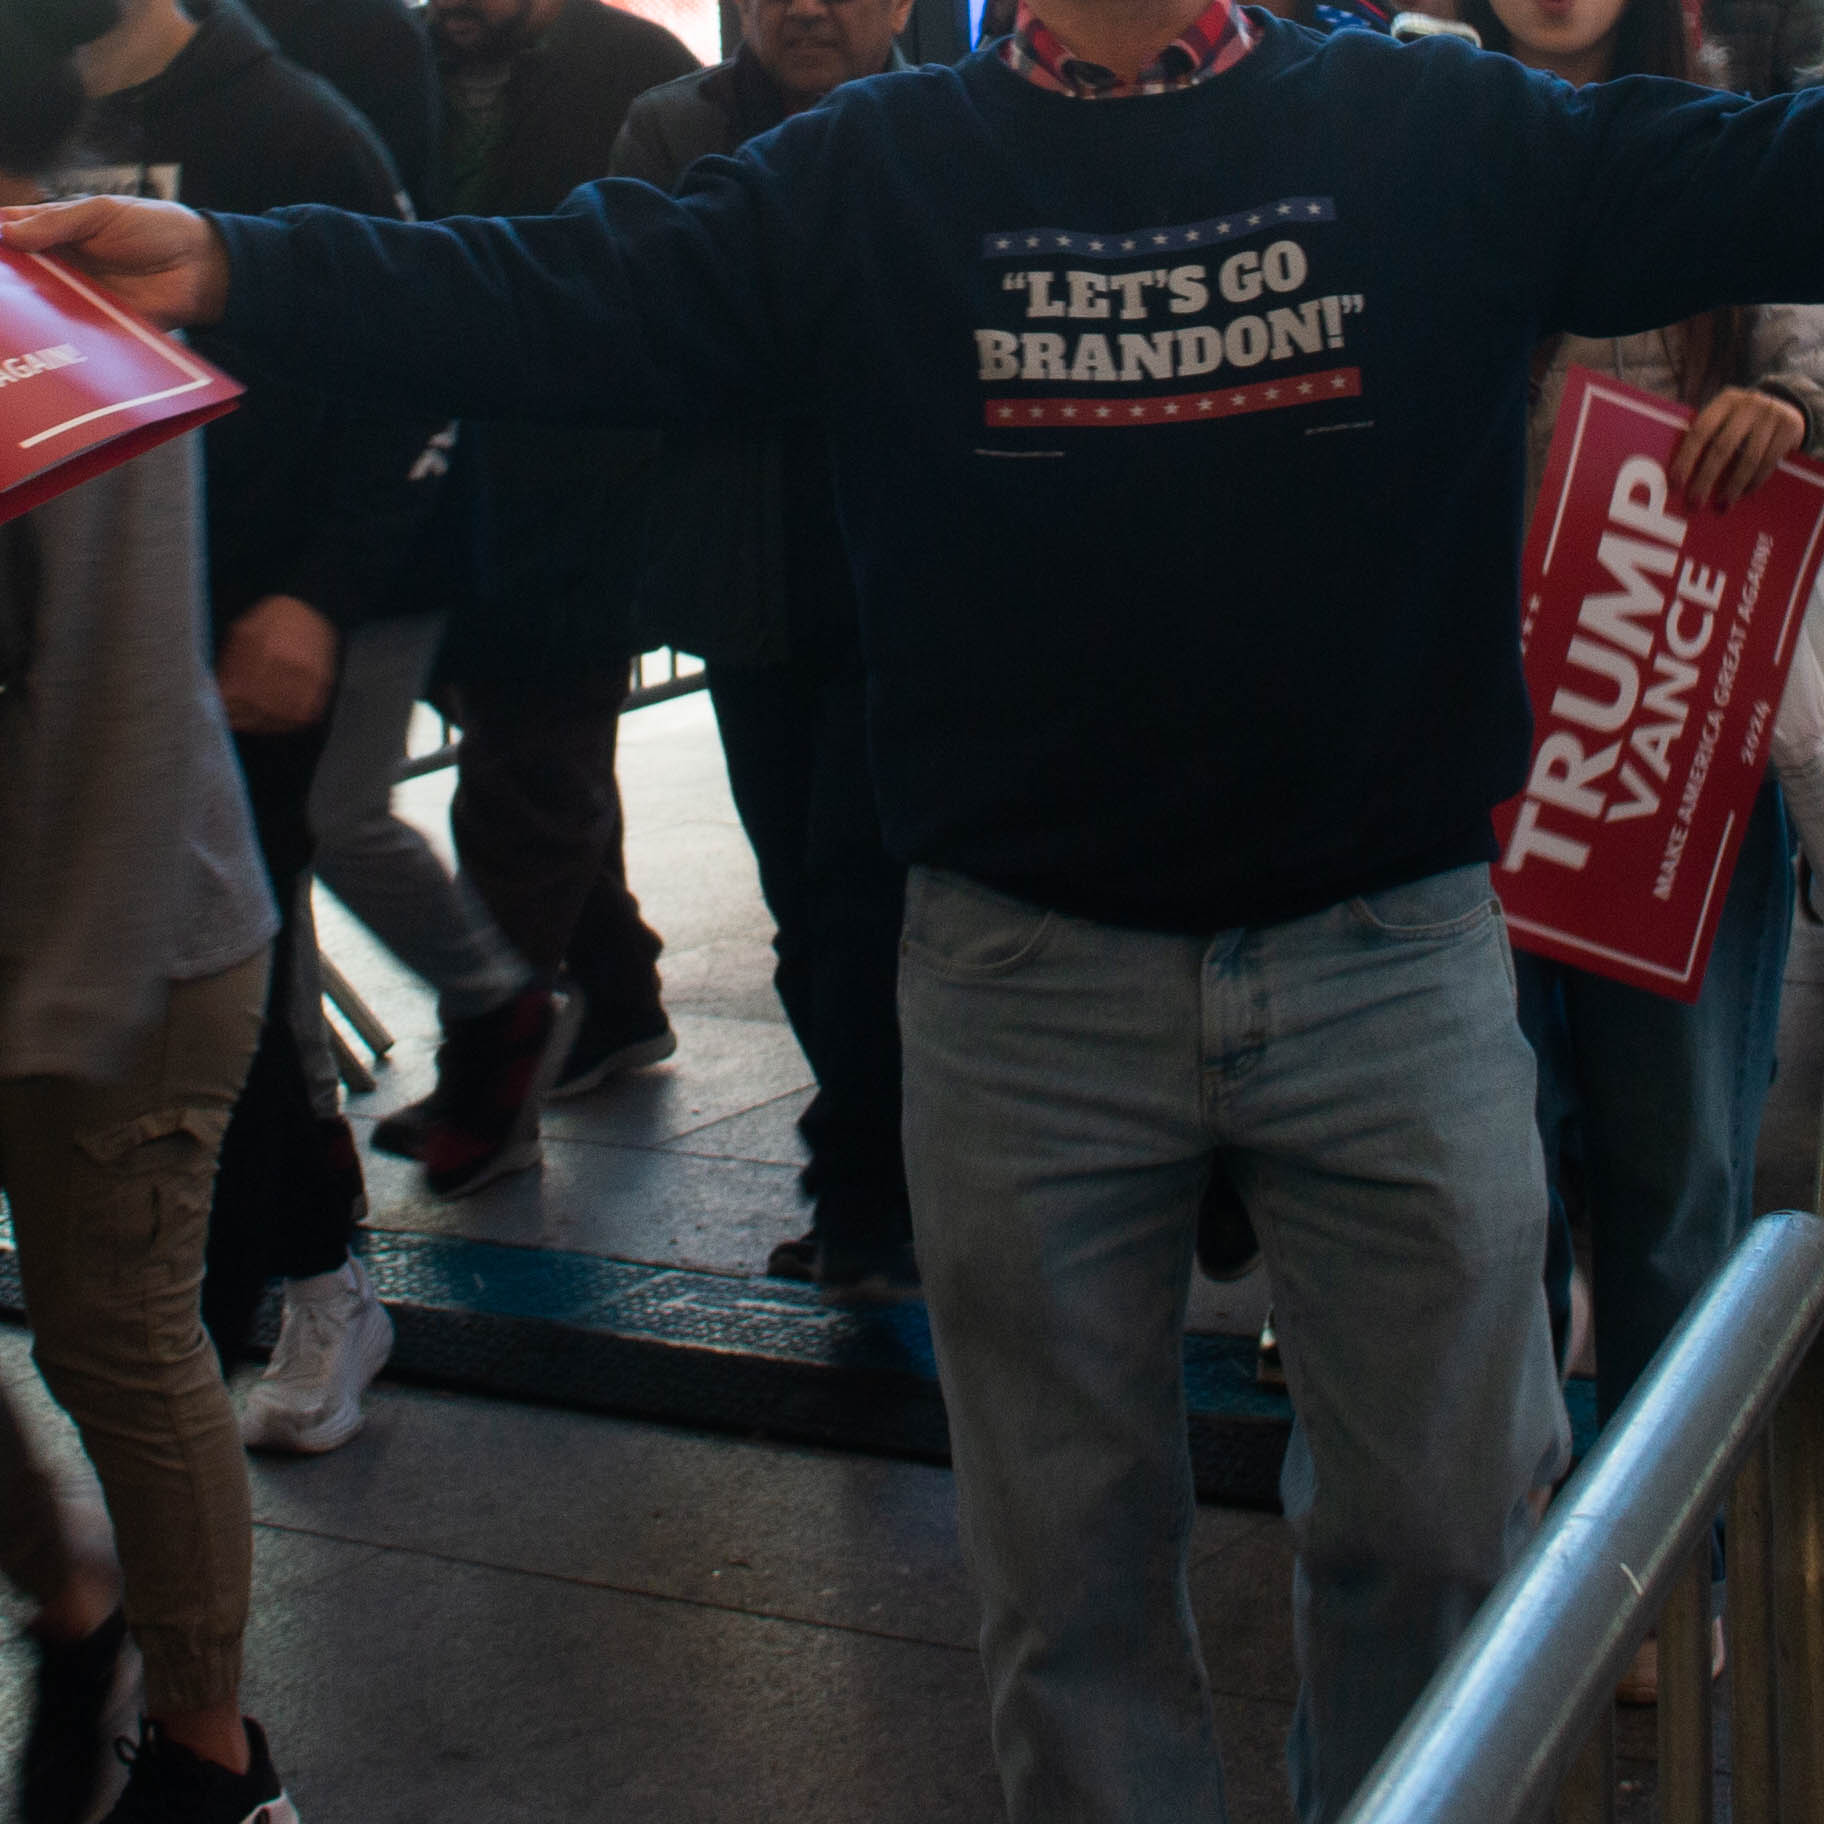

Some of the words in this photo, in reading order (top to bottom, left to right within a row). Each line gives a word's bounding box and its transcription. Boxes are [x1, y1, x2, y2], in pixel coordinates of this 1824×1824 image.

[973, 293, 1366, 383] BRANDON!”
[1001, 263, 1210, 320] “LET’S
[1219, 239, 1308, 304] GO
[1501, 453, 1688, 874] TRUMP
[1604, 557, 1727, 824] VANCE
[1740, 698, 1773, 767] 2024
[1653, 823, 1690, 901] MAKE
[1677, 710, 1726, 826] AMERICA
[1713, 621, 1748, 708] GREAT
